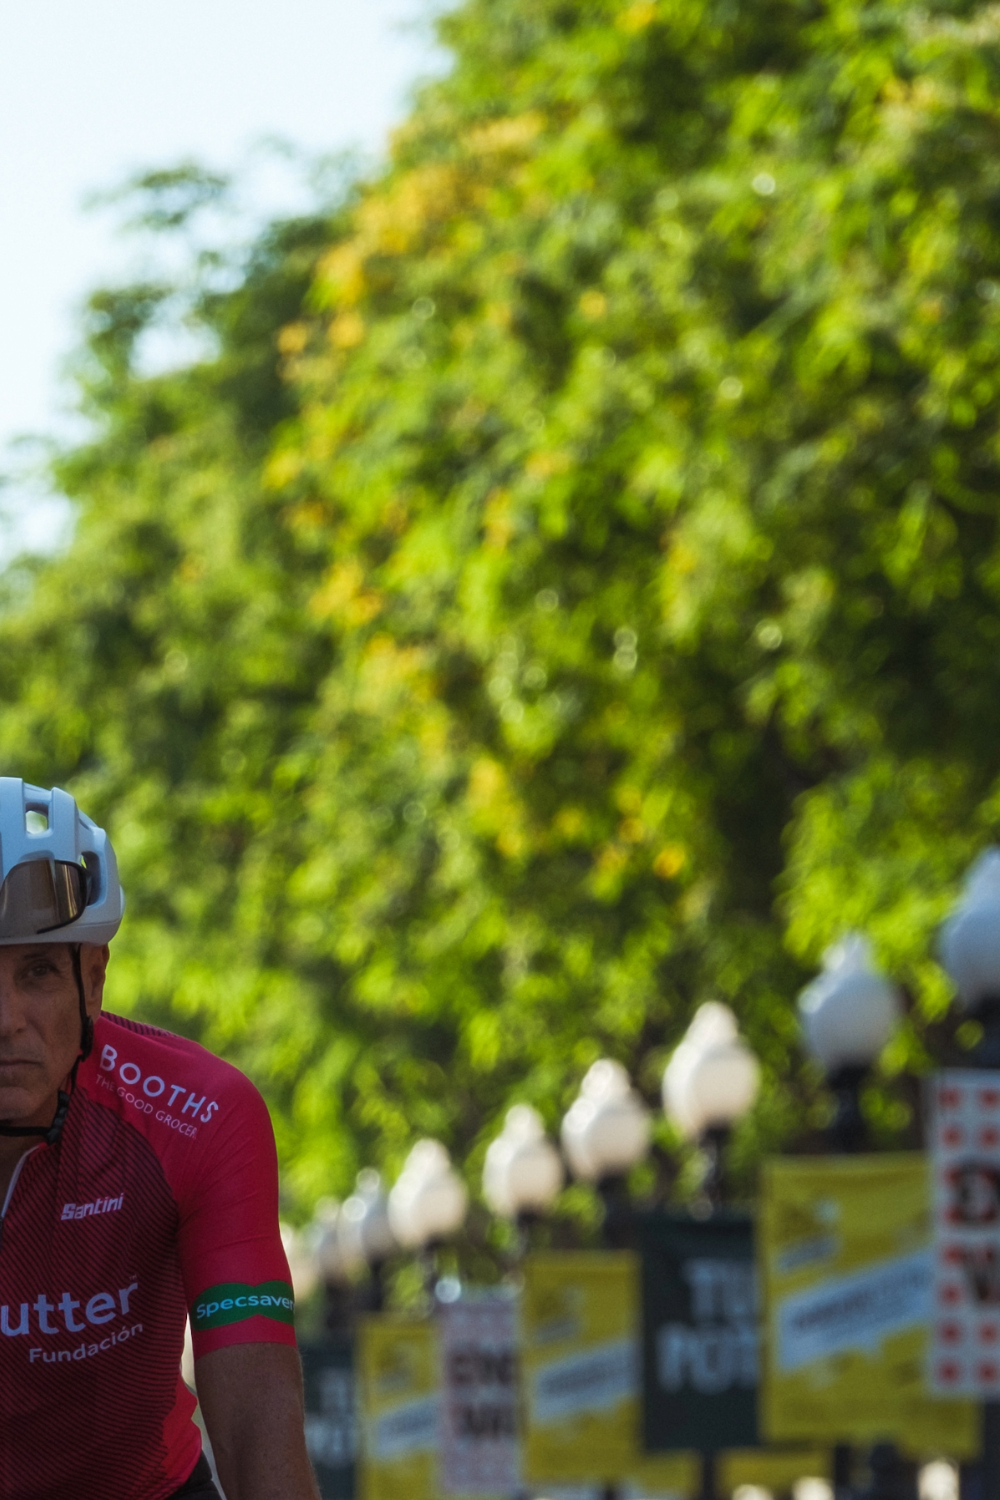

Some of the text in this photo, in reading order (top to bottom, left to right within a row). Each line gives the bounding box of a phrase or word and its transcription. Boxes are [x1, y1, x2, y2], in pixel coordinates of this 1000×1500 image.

[96, 1074, 116, 1092] THE
[117, 1087, 154, 1114] GOOD
[100, 1044, 219, 1123] BOOTHS
[60, 1192, 125, 1221] Santini
[29, 1323, 144, 1363] Fundación
